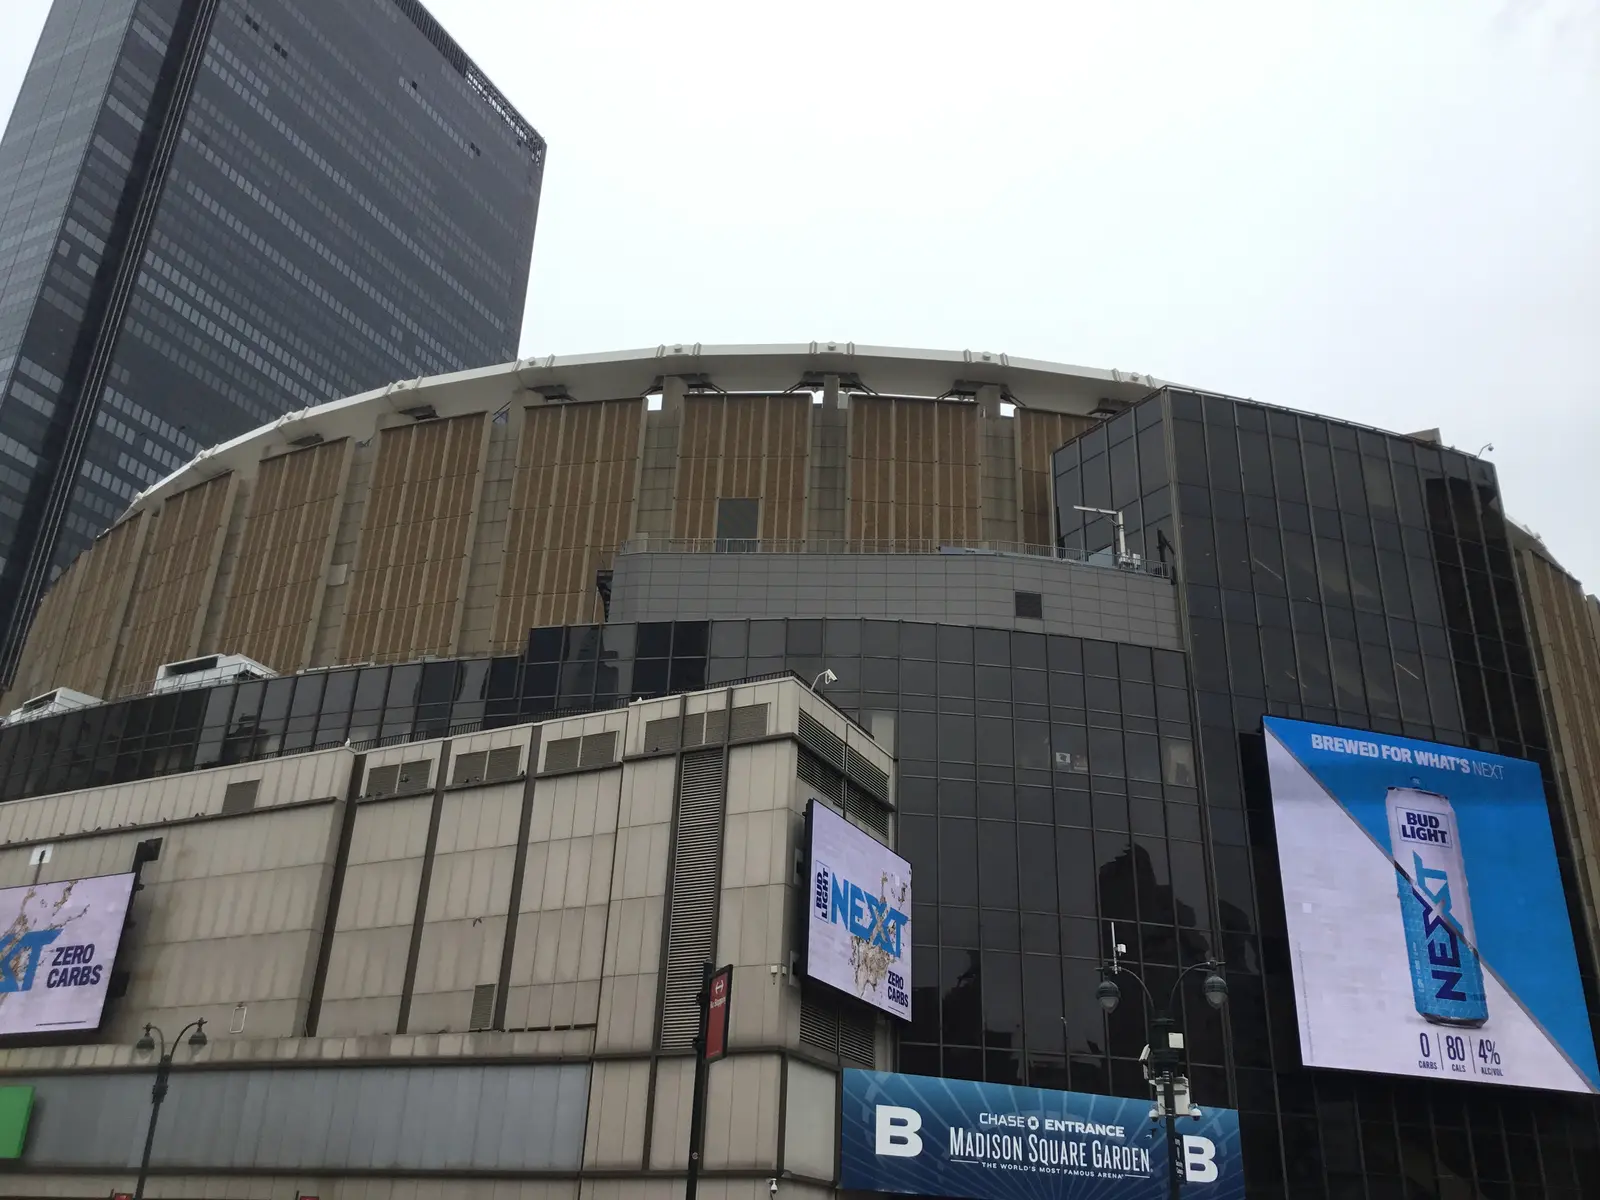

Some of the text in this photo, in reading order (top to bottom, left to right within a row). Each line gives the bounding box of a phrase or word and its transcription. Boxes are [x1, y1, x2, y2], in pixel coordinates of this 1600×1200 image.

[1311, 733, 1504, 780] BREWED FOR WHAT'S NEXT
[1401, 824, 1447, 843] LIGHT
[1405, 812, 1440, 828] BUD
[815, 871, 823, 909] BUD
[821, 868, 829, 920] LIGHT
[830, 871, 909, 958] NEXT
[1412, 849, 1467, 1002] NEXT
[52, 943, 95, 967] ZERO
[46, 964, 103, 989] CARBS
[887, 970, 904, 990] ZERO
[887, 986, 909, 1008] CARBS
[1420, 1032, 1501, 1065] 0 80 4%
[1418, 1060, 1438, 1070] CARBS
[1452, 1063, 1467, 1073] CALS
[875, 1104, 923, 1158] B
[979, 1112, 1125, 1138] CHASE ENTRANCE
[950, 1126, 1023, 1162] MADISON
[1028, 1134, 1087, 1167] SQUARE
[1092, 1140, 1151, 1173] GARDEN
[1182, 1134, 1219, 1183] B
[982, 1161, 997, 1169] THE
[1000, 1163, 1036, 1172] WORLD'S
[1039, 1167, 1061, 1175] MOST
[1063, 1169, 1095, 1178] FAMOUS
